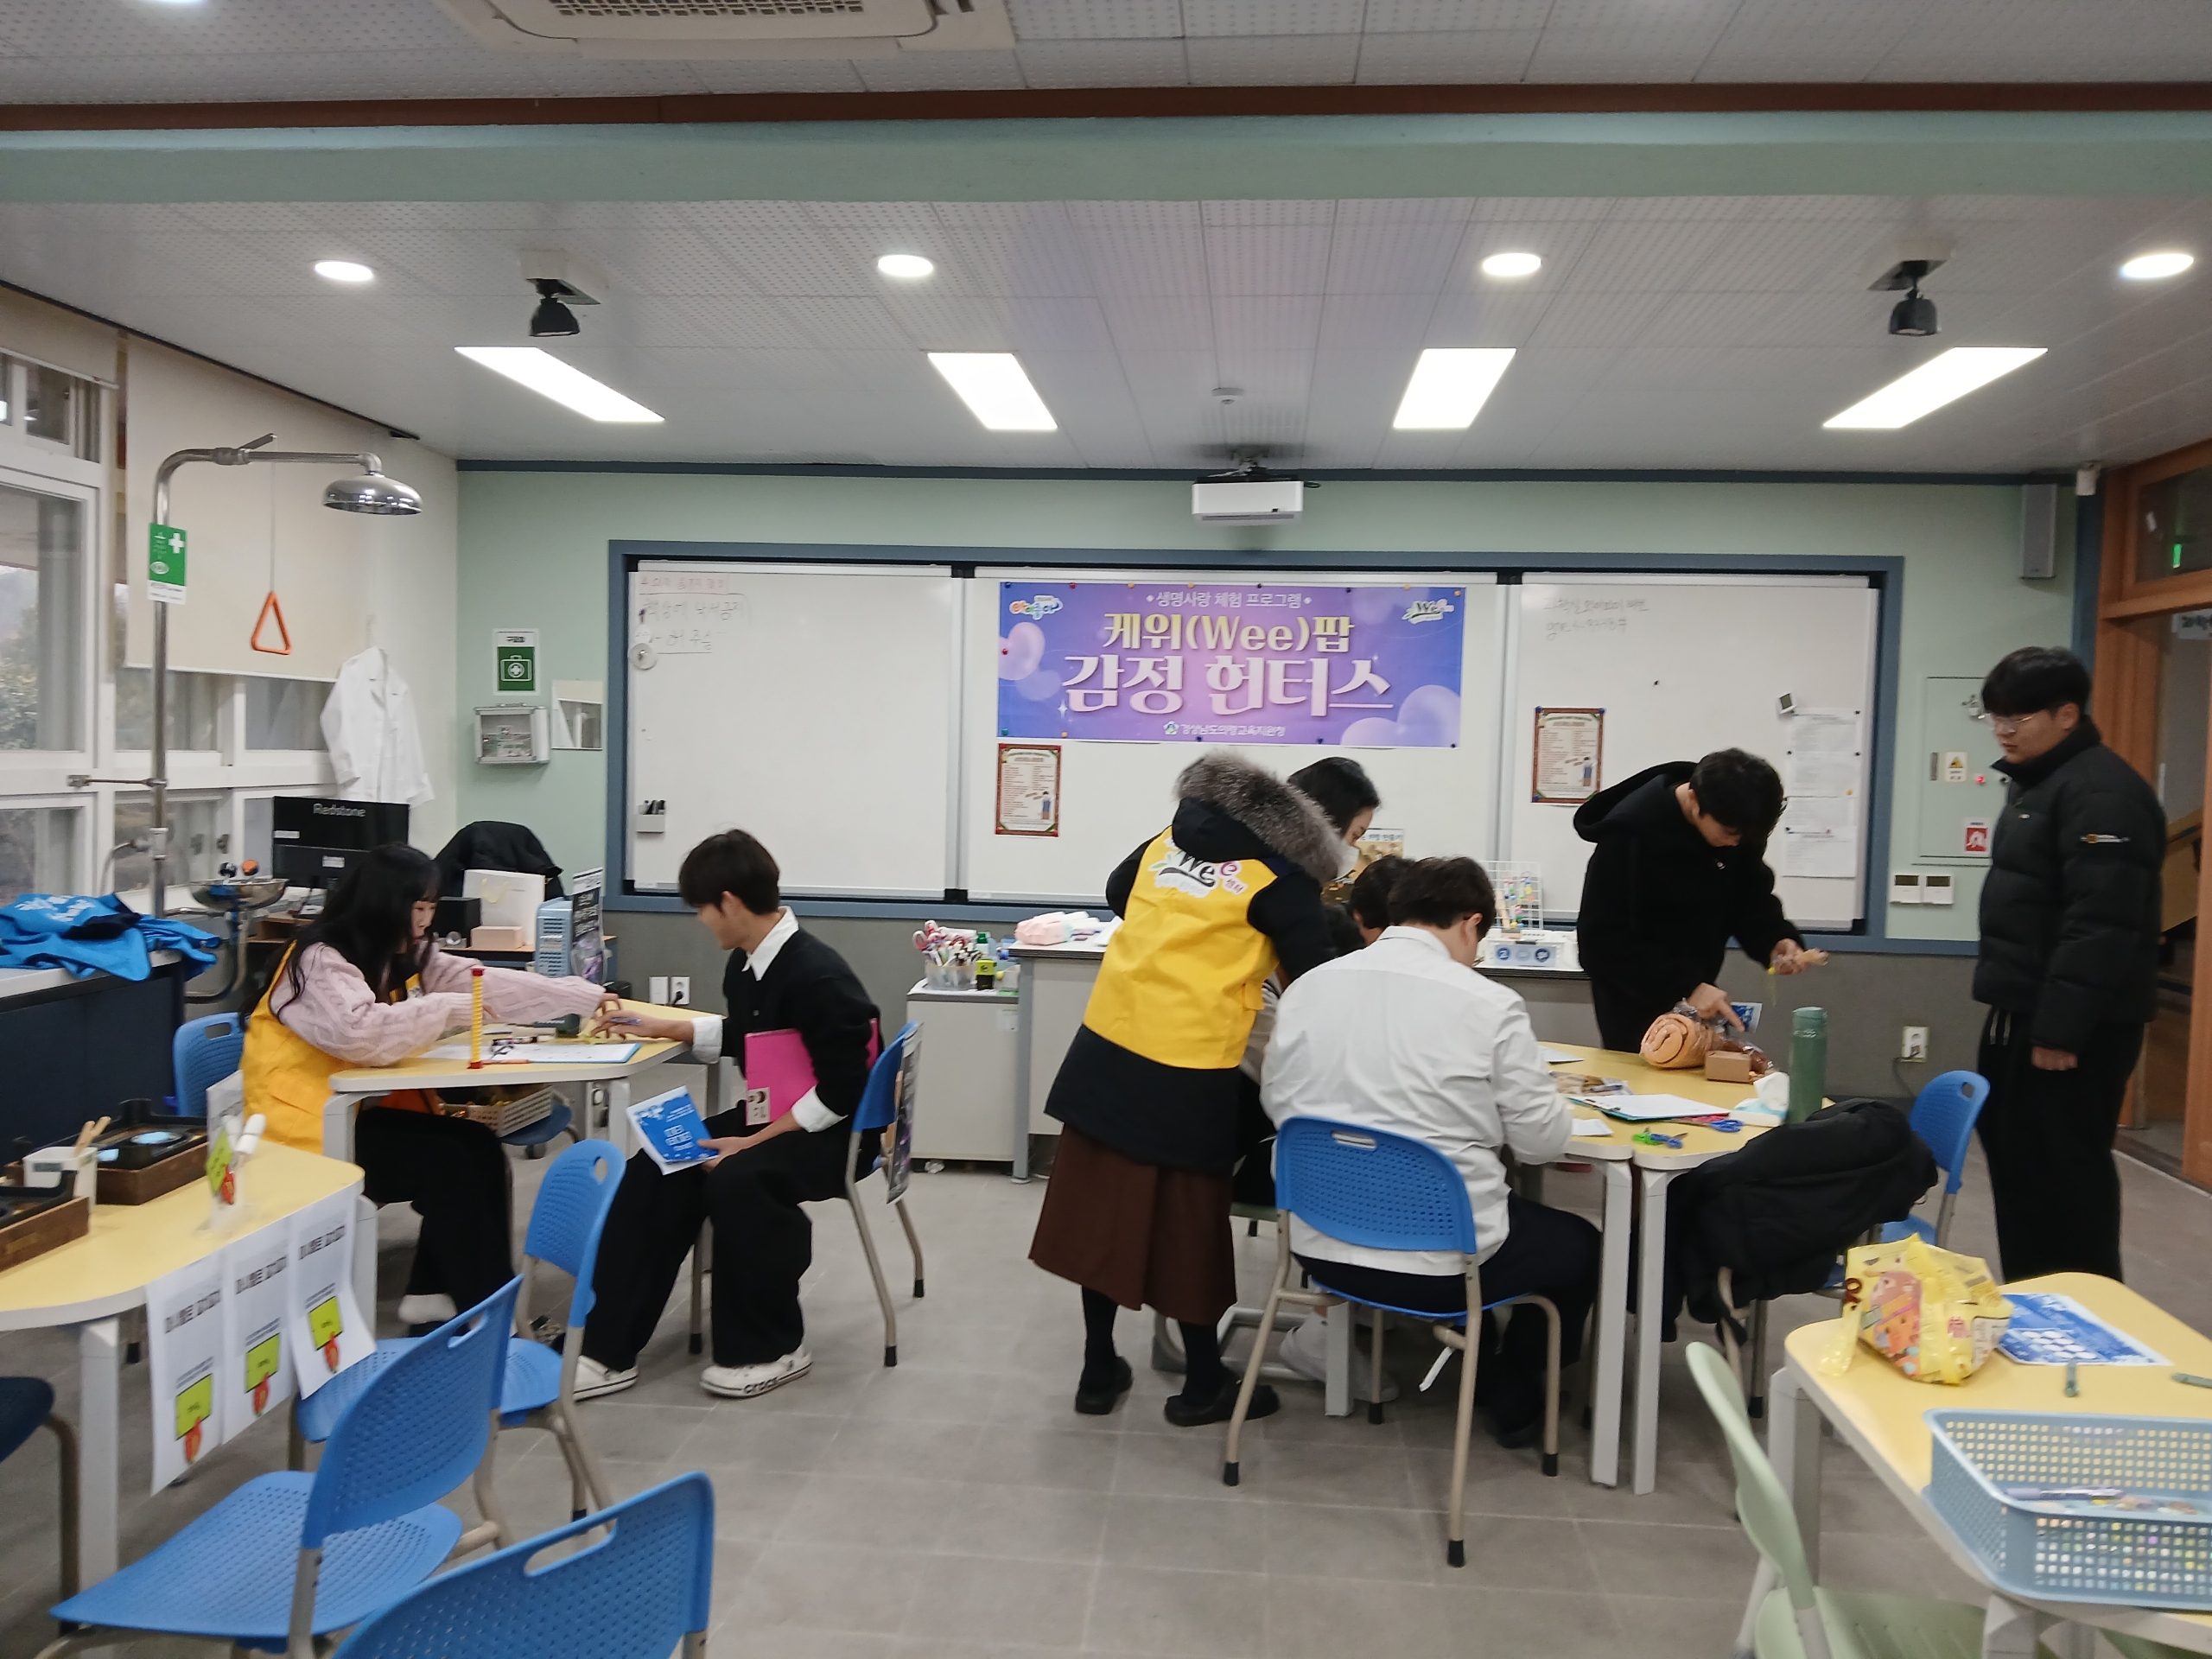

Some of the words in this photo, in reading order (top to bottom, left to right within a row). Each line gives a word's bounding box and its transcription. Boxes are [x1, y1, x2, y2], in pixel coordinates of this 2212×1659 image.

[1156, 591, 1211, 607] 생명사랑
[1214, 592, 1243, 607] 체험
[1245, 593, 1302, 609] 프로그램
[1103, 612, 1355, 653] 케위(Wee)팝
[1062, 654, 1184, 715] 감정
[1204, 655, 1395, 717] 헌터스
[313, 803, 366, 817] Redstone
